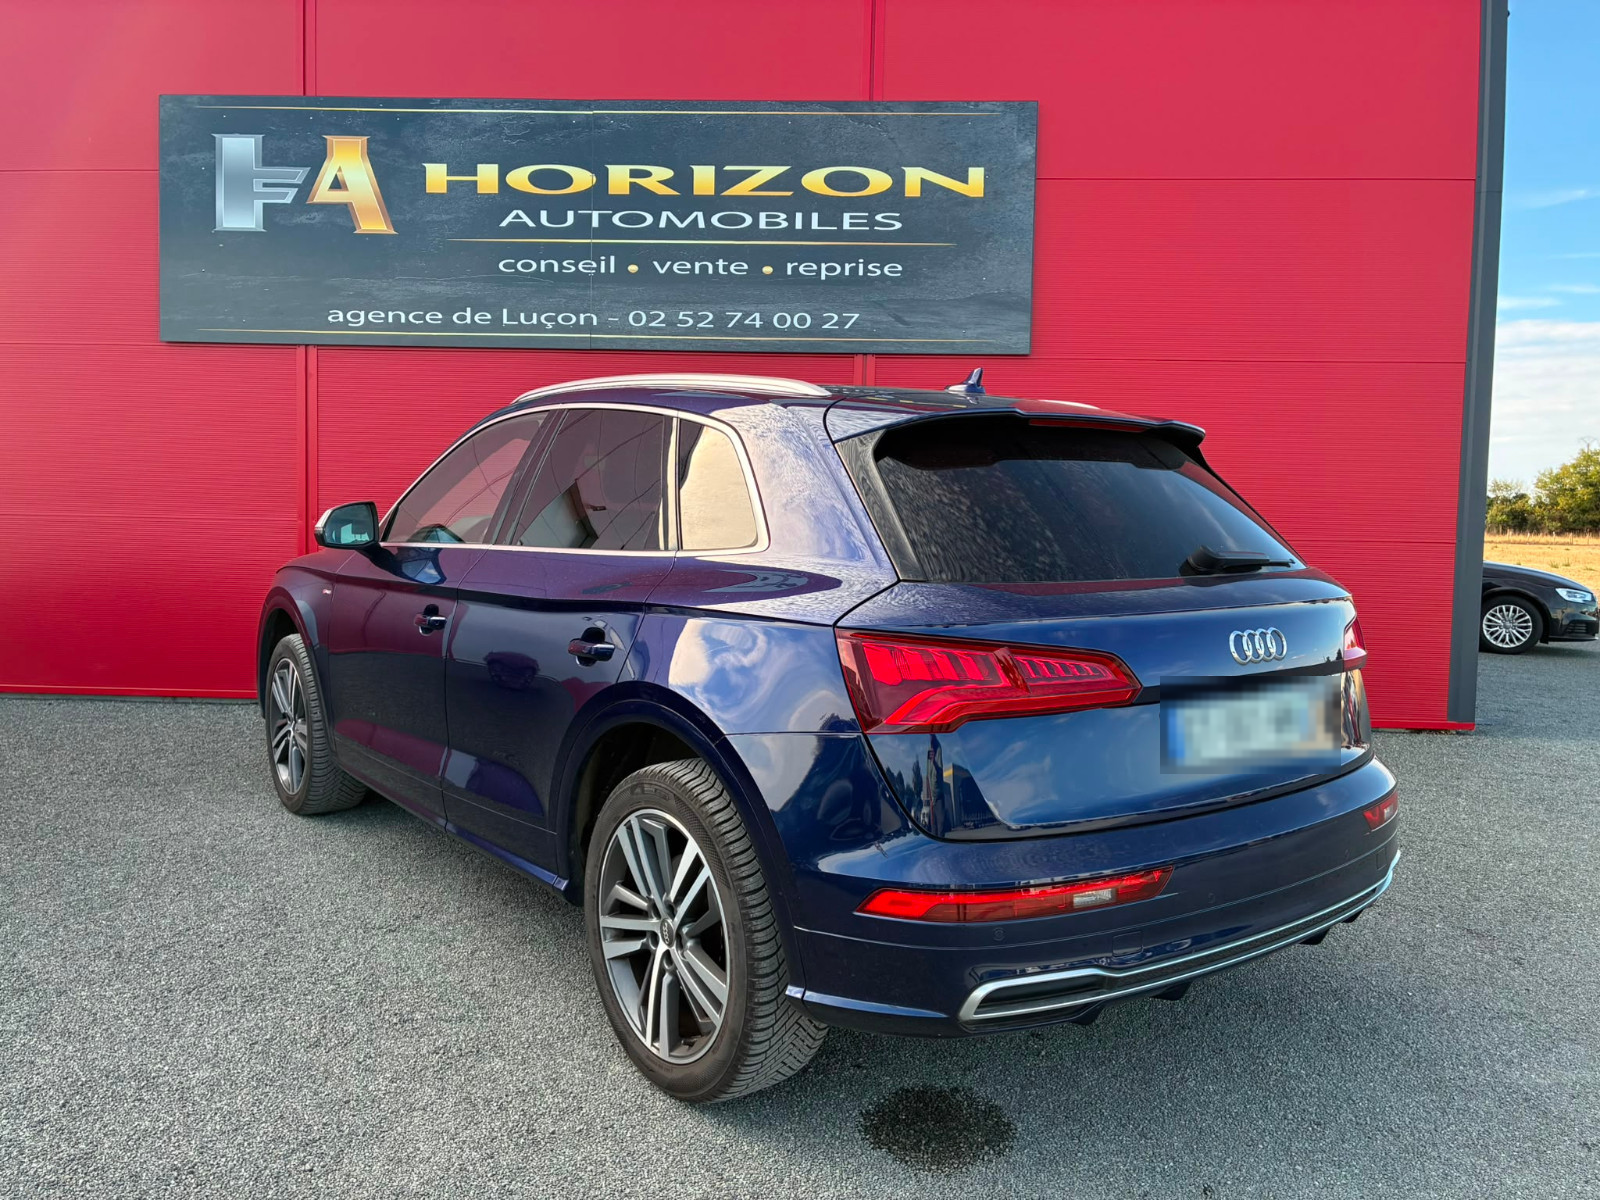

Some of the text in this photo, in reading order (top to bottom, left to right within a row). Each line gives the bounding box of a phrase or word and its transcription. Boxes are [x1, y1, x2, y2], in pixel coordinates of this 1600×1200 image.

[422, 162, 986, 198] HORIZON
[499, 209, 903, 231] AUTOMOBILES
[498, 256, 904, 280] conseil vente reprise
[327, 307, 444, 326] agence
[452, 307, 492, 325] de
[502, 308, 599, 329] Luçon
[628, 310, 667, 328] 02
[677, 311, 715, 329] 52
[725, 312, 763, 329] 74
[773, 312, 812, 330] 00
[822, 313, 860, 330] 27
